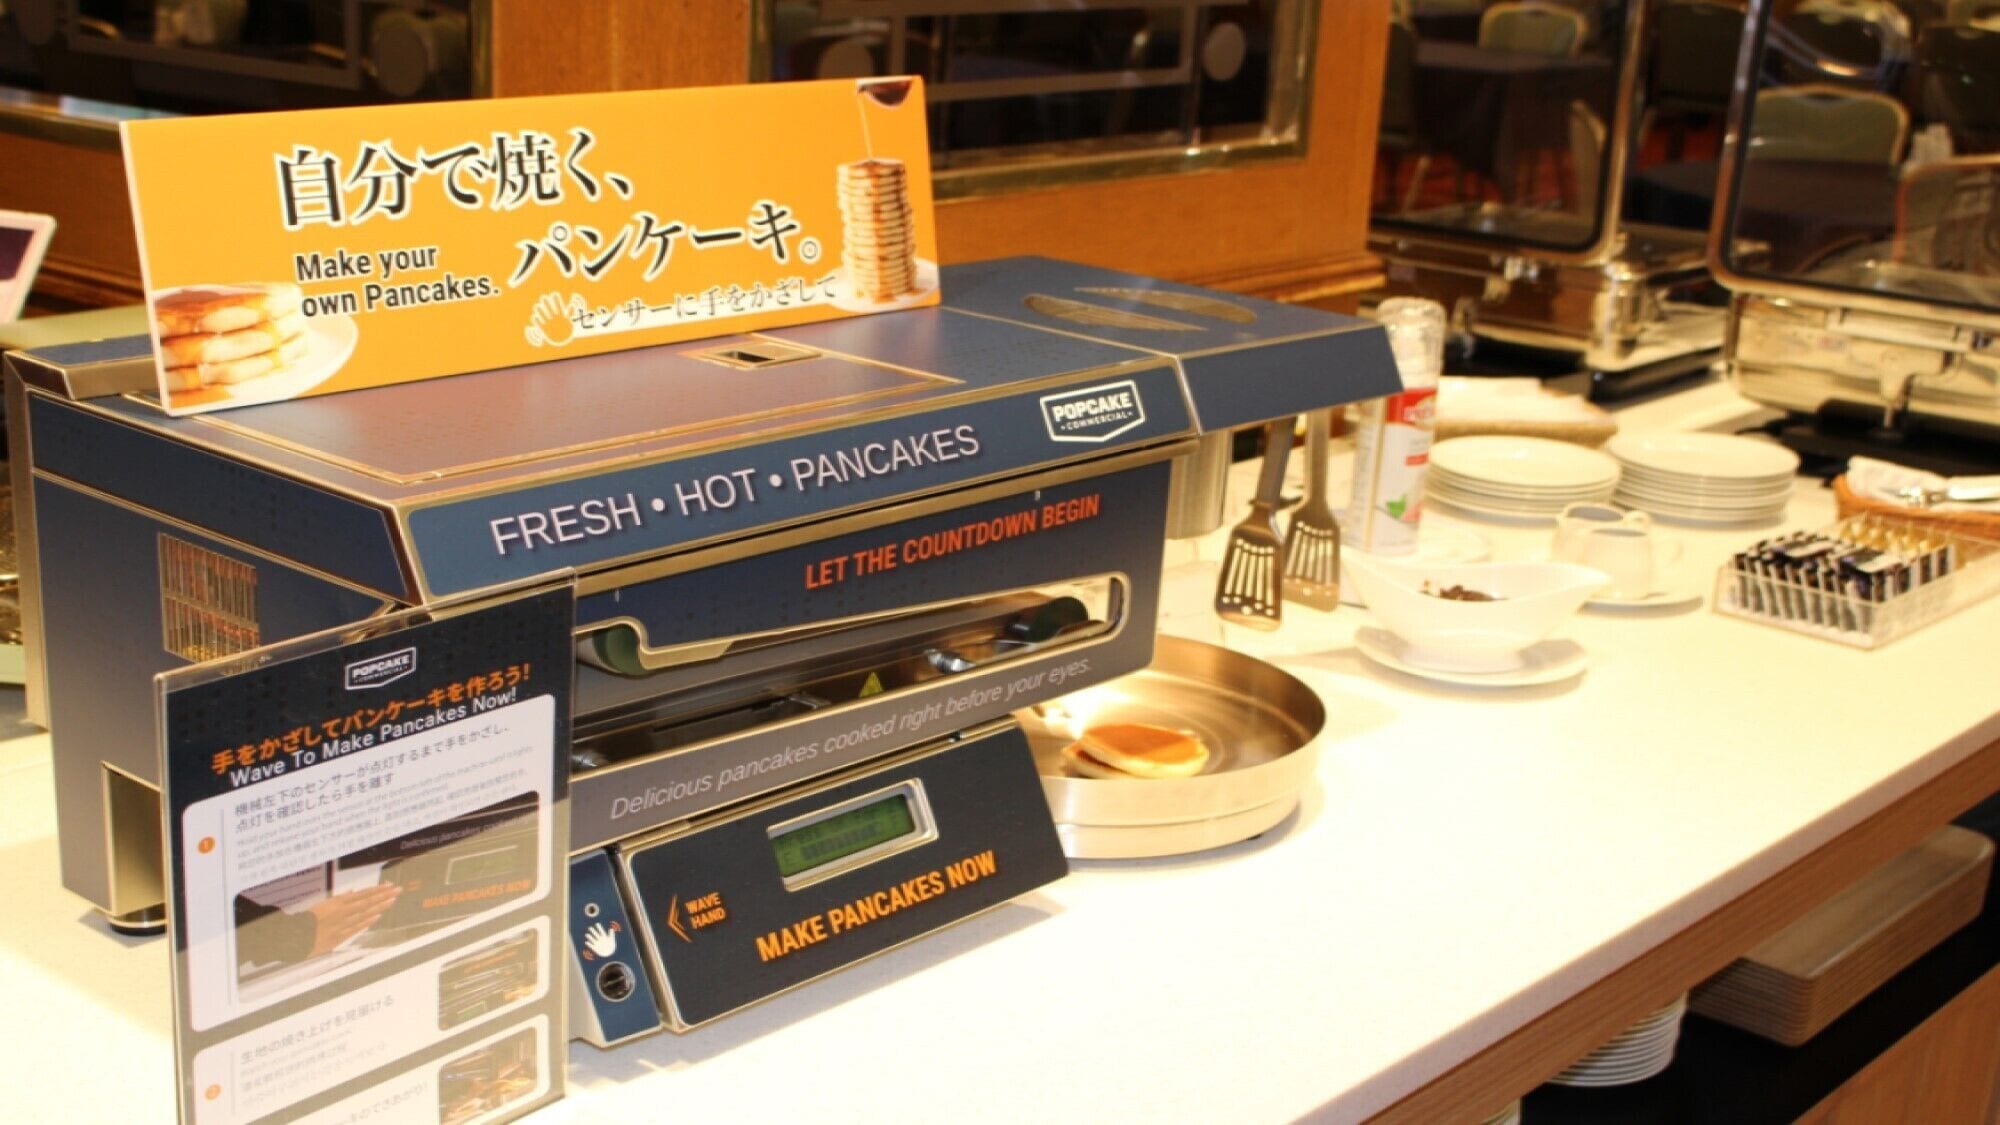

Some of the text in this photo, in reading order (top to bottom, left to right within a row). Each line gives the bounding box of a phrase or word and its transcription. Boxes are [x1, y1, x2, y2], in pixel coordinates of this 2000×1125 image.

[278, 129, 630, 227] 自分で焼く、
[297, 247, 437, 283] Make your
[511, 203, 819, 281] パンケーキ。
[303, 275, 499, 317] own Pancakes.
[572, 276, 836, 328] センサーに手をかざして
[1052, 392, 1132, 422] POPCAKE
[490, 425, 979, 555] FRESH HOT PANCAKES
[805, 494, 1100, 590] LET THE COUNTDOWN BEGIN
[230, 687, 517, 788] Wave To Make Pancakes Now!
[610, 657, 1092, 820] Delicious pancakes cooked right before your eyes.
[685, 892, 721, 913] WAVE
[691, 907, 726, 929] HAND
[756, 850, 998, 963] MAKE PANCAKES NOW
